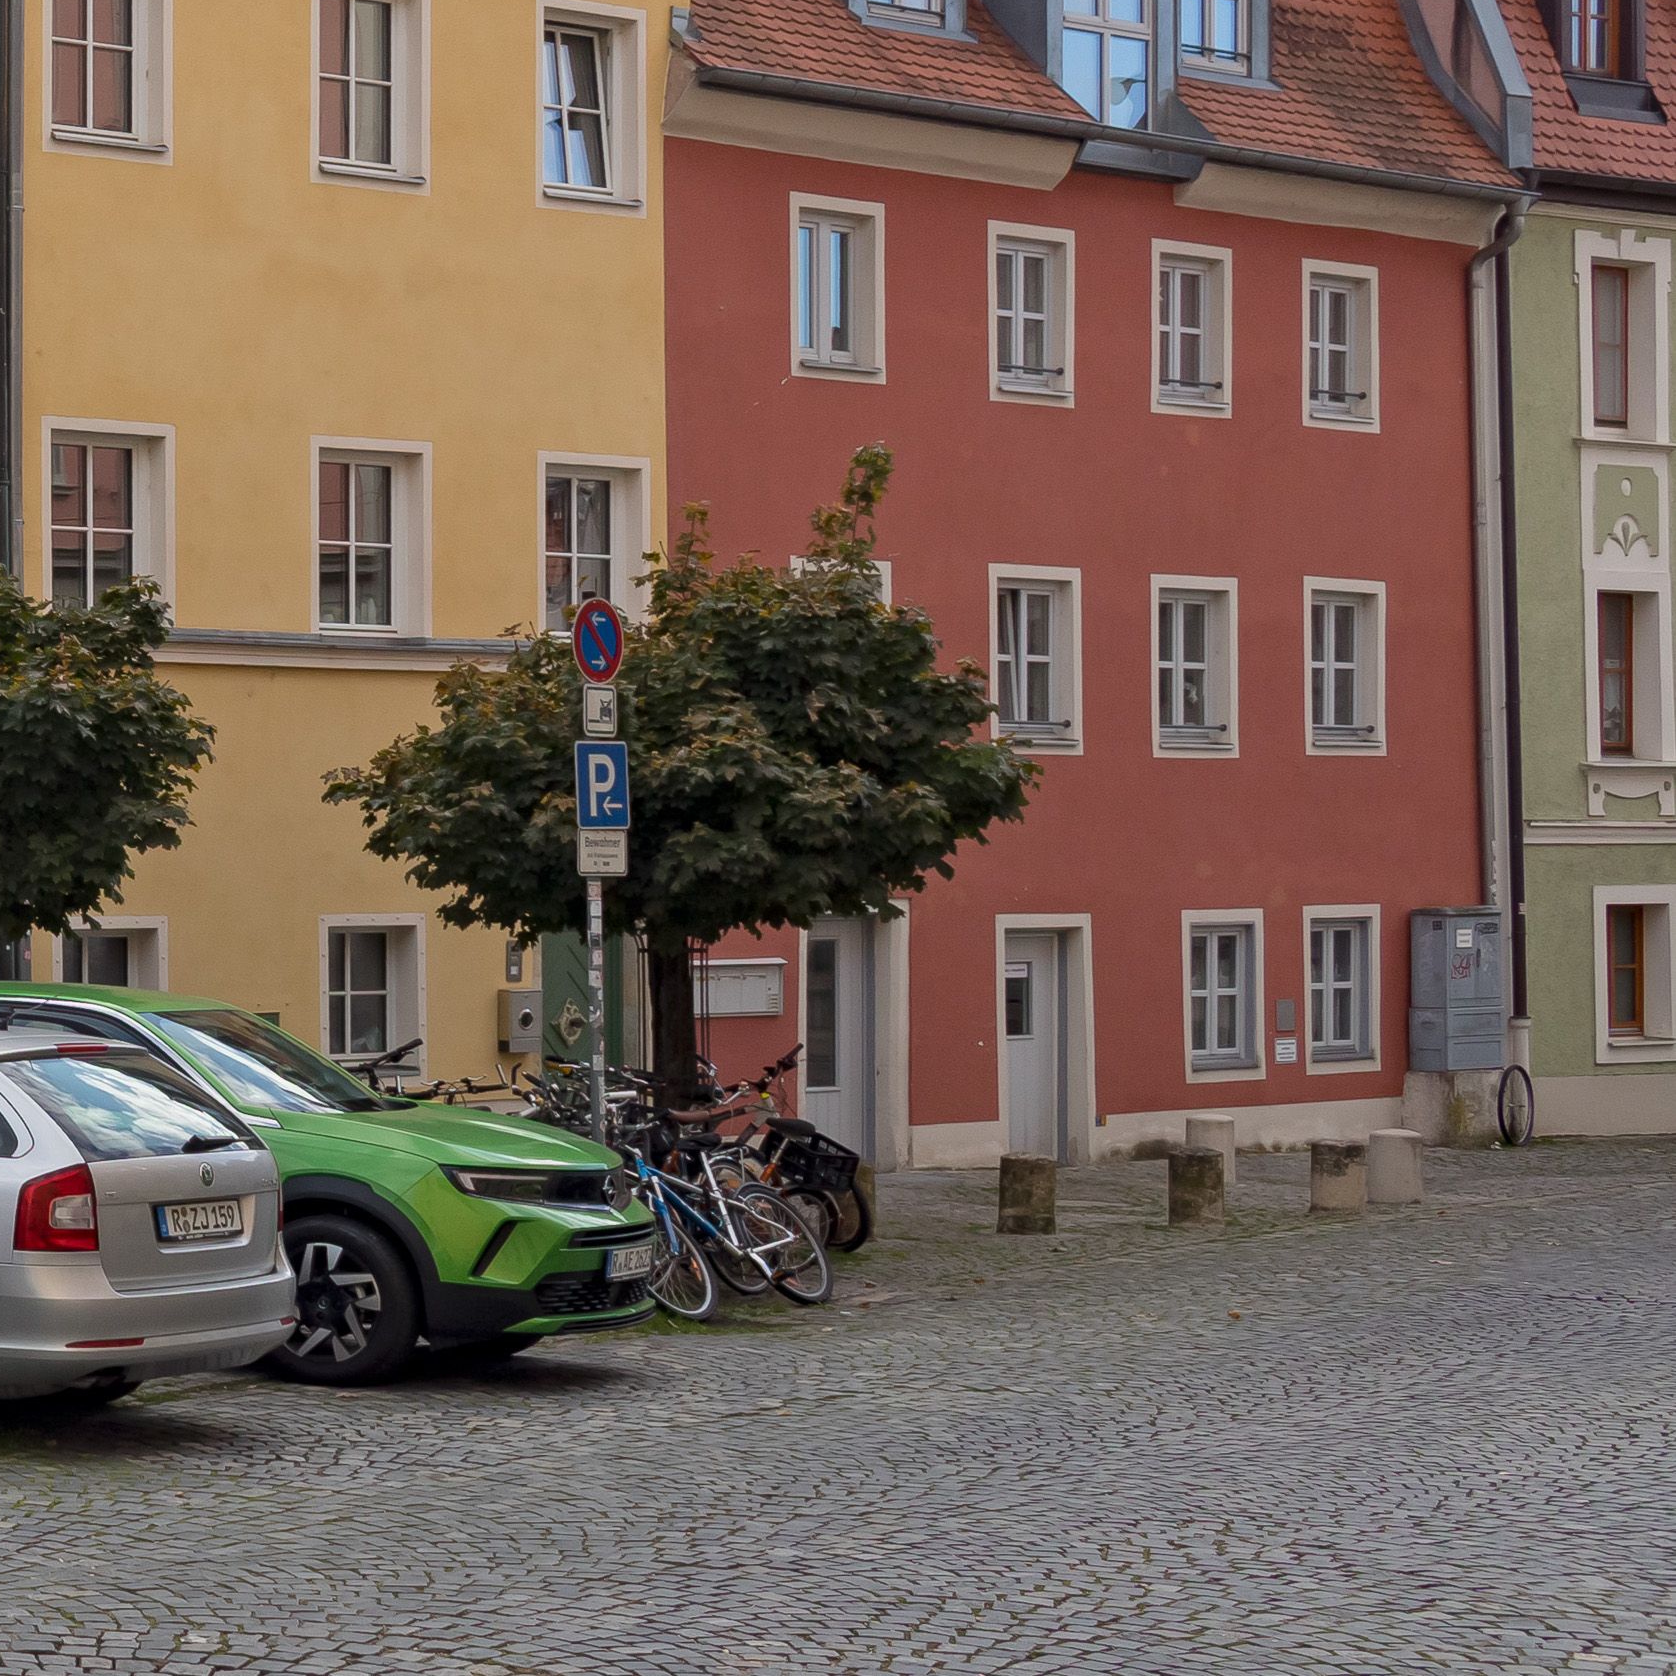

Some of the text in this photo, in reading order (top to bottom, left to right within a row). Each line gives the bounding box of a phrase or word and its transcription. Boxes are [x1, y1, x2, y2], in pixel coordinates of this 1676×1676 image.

[588, 754, 615, 817] P
[171, 1205, 236, 1233] R ZJ 159
